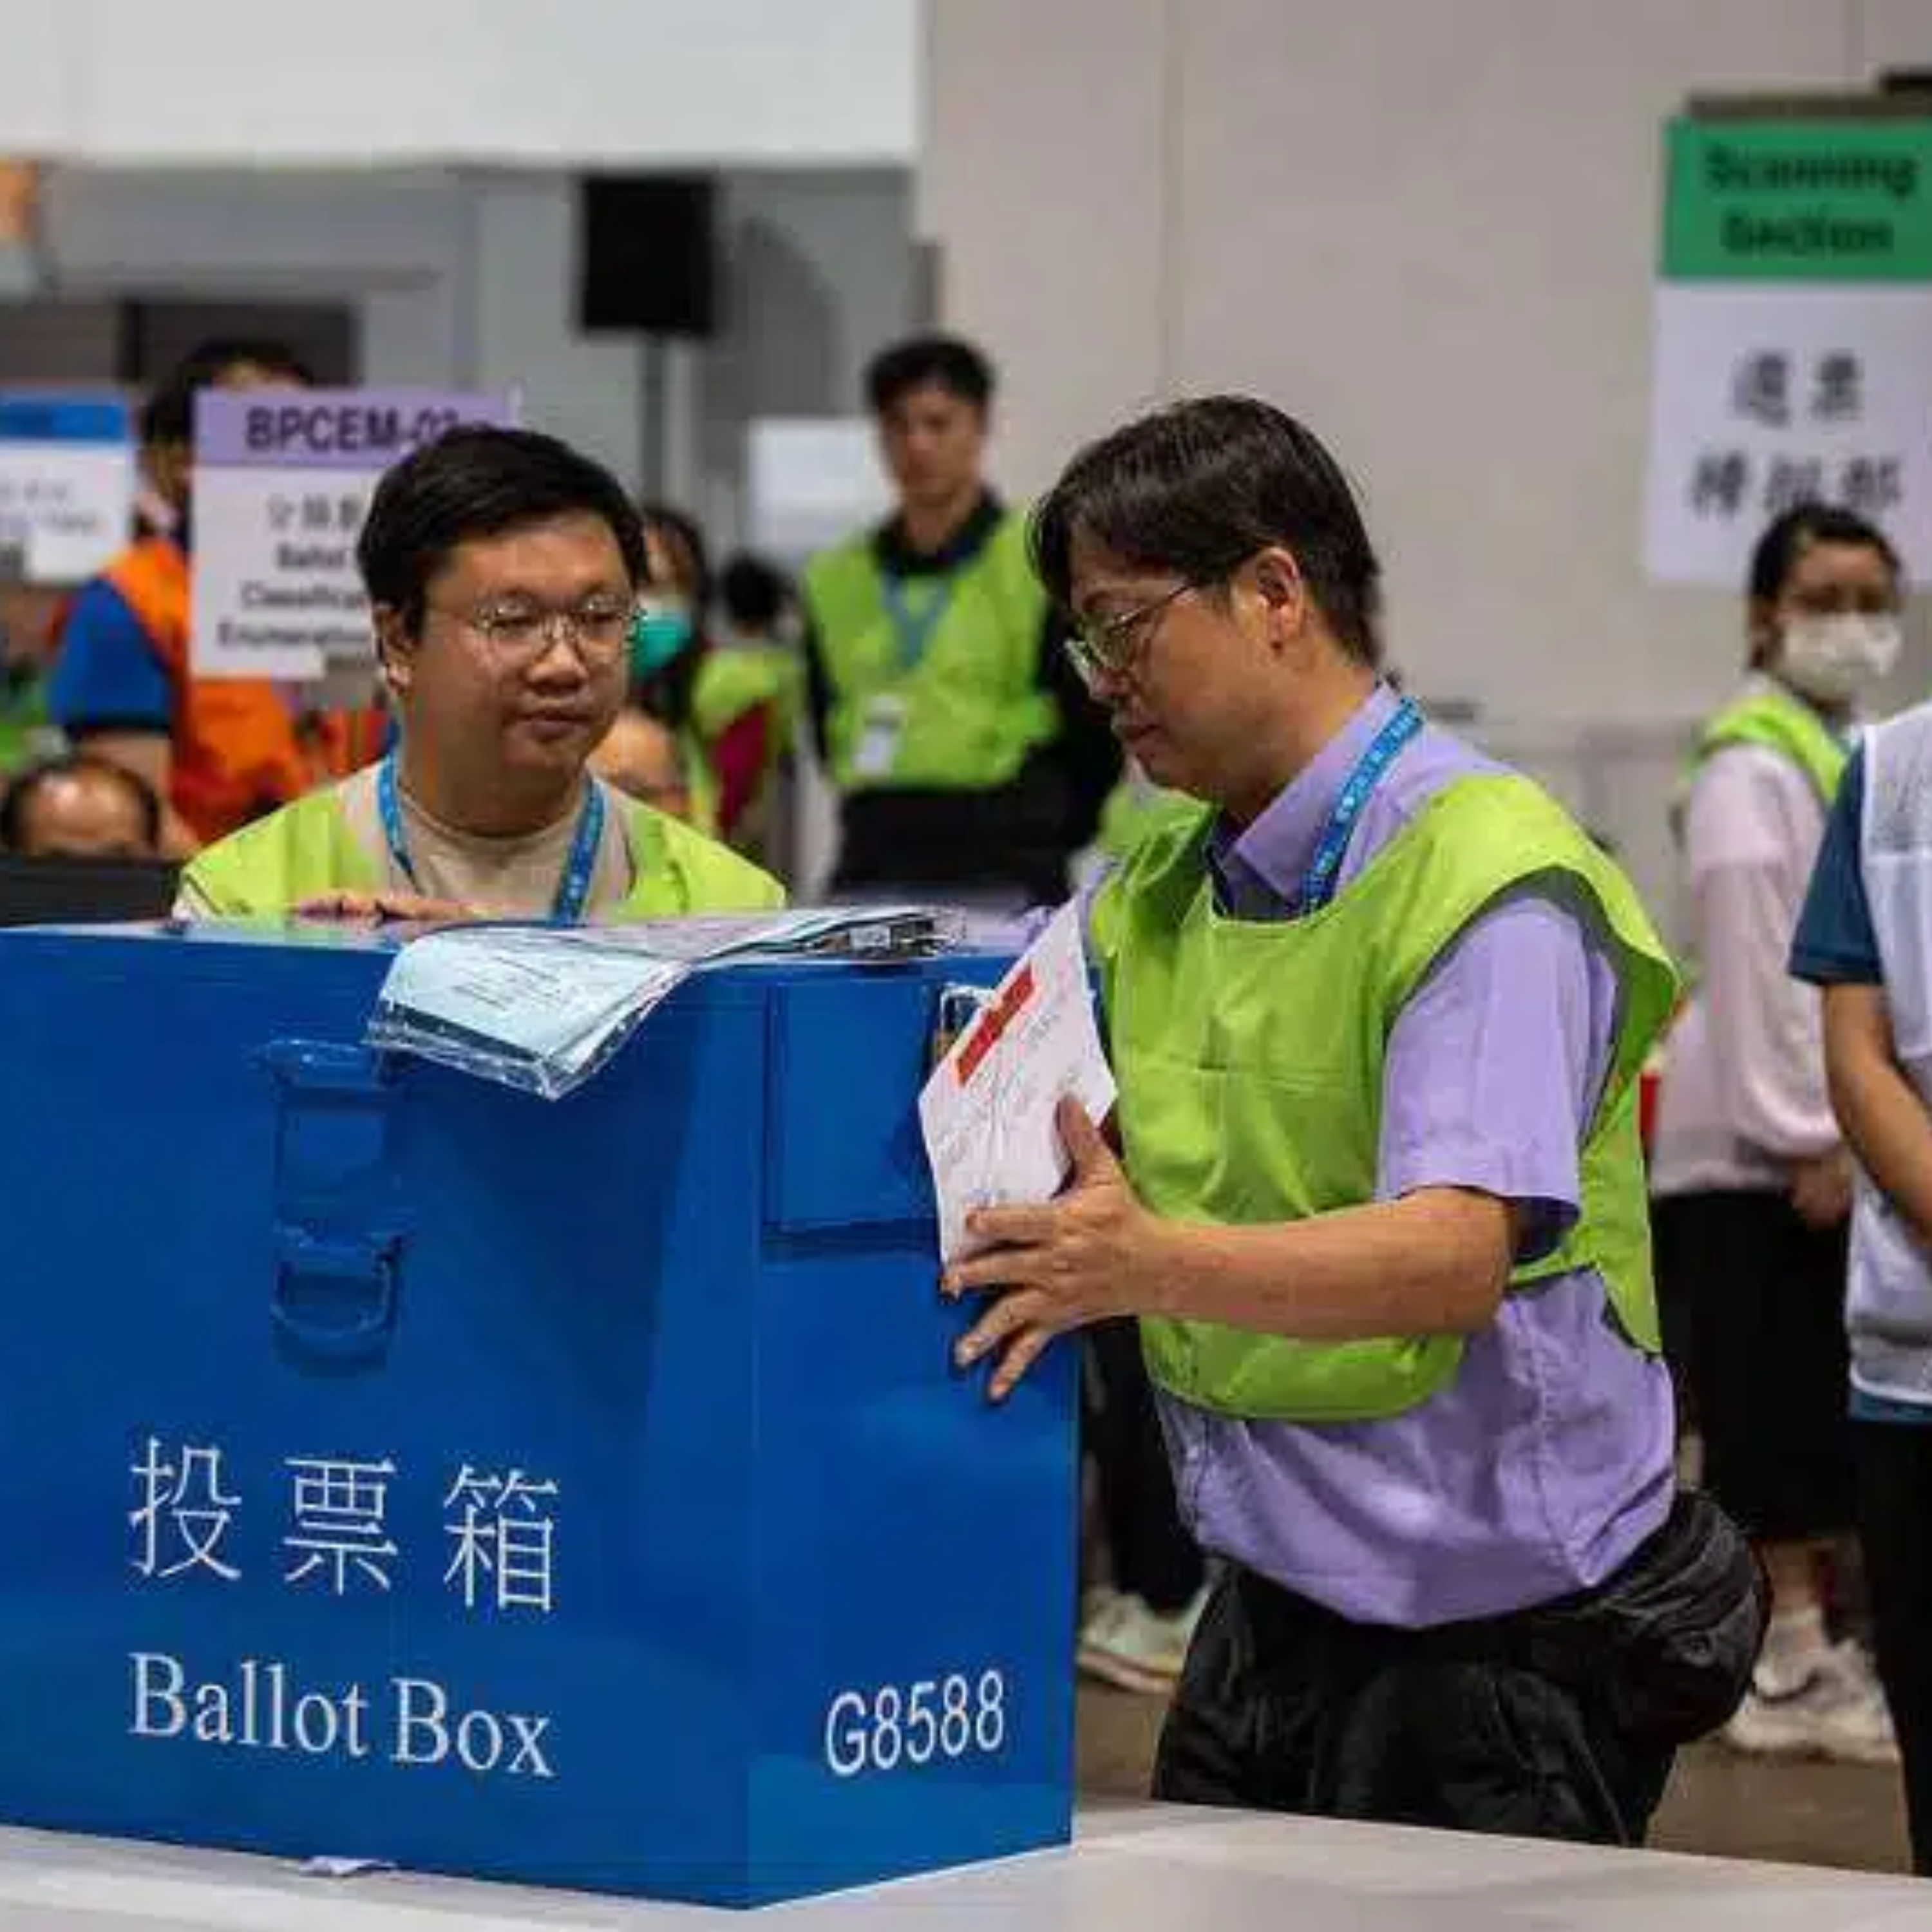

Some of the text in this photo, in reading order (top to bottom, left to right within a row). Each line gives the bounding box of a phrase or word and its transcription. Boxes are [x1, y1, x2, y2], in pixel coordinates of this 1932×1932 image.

[129, 1437, 558, 1611] 投票箱
[129, 1653, 555, 1777] Ballot Box
[827, 1671, 1004, 1777] G8588
